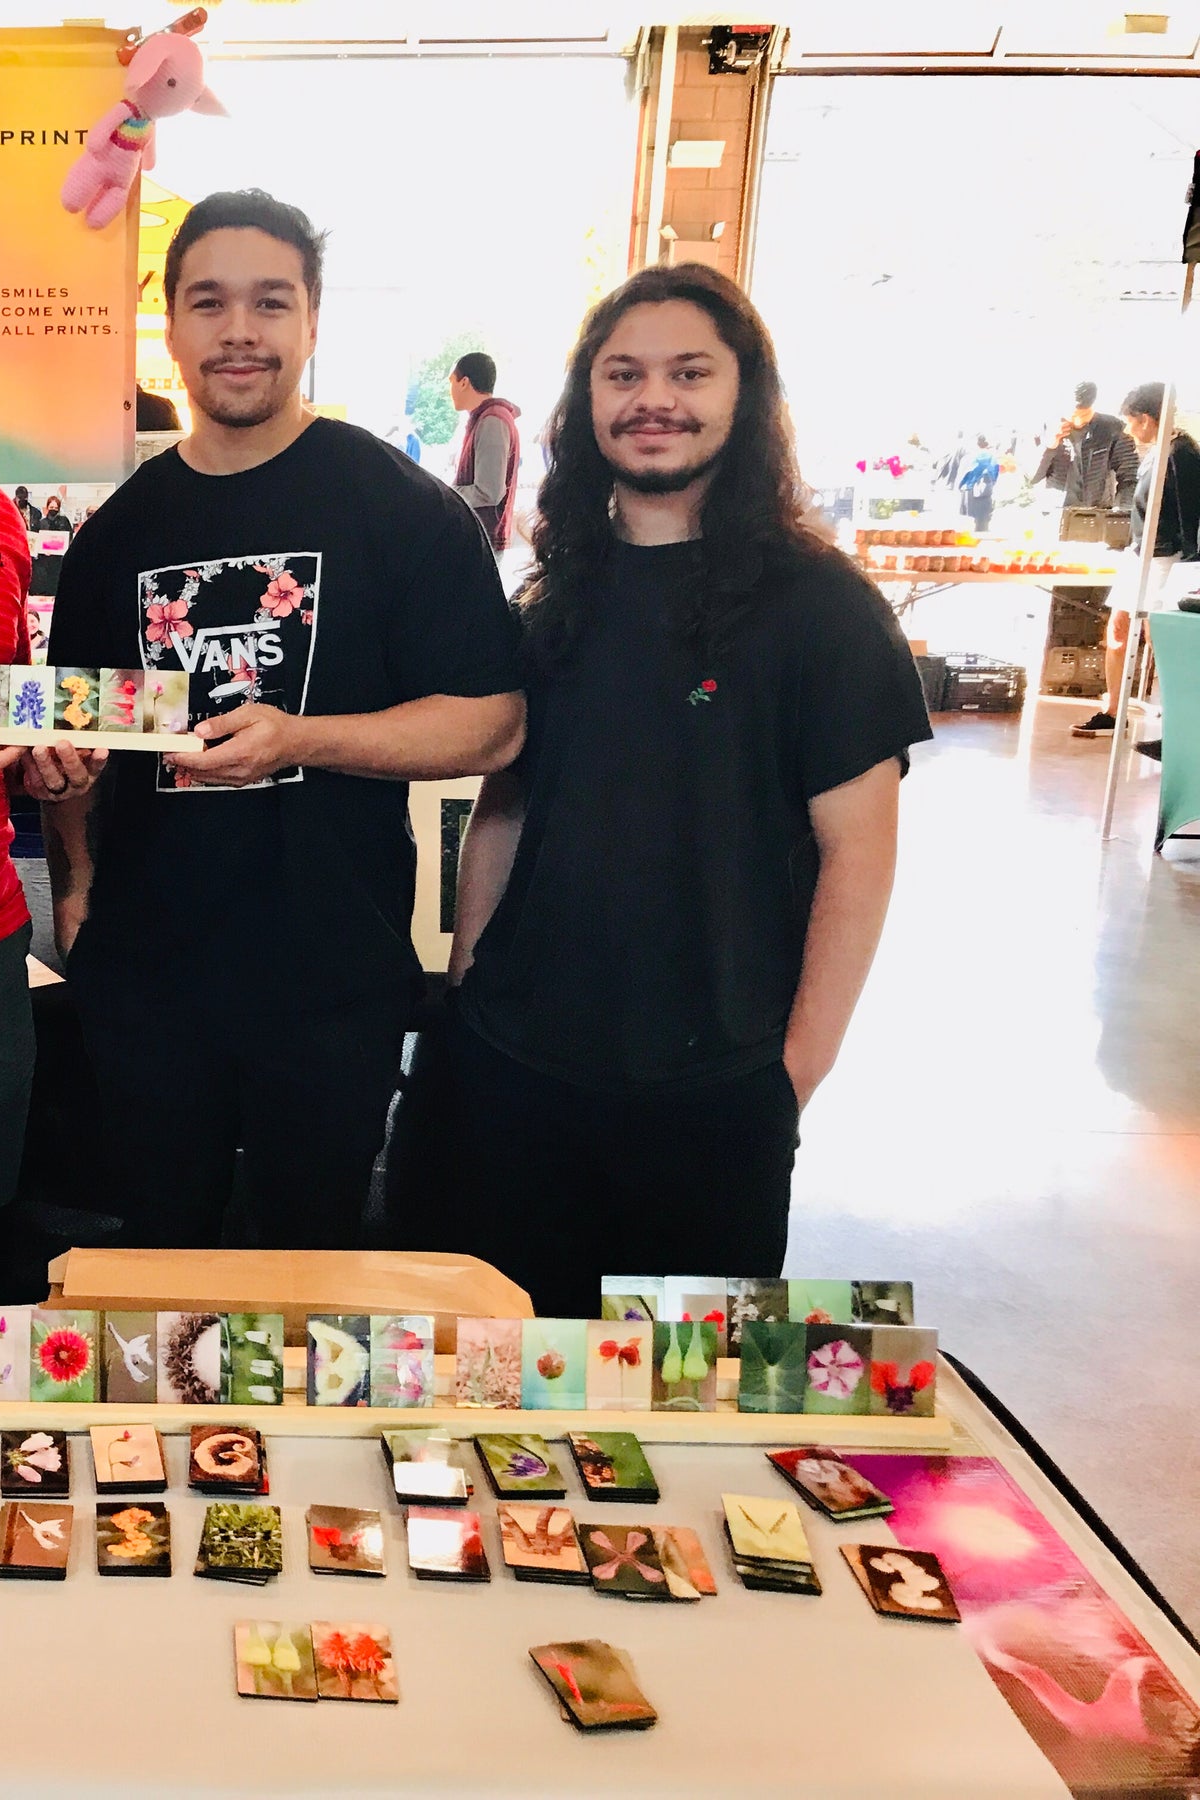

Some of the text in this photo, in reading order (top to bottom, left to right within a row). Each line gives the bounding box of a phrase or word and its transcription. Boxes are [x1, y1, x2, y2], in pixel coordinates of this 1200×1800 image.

[1, 287, 69, 298] SMILES
[1, 306, 109, 317] COME WITH
[2, 325, 119, 336] ALL PRINTS.
[169, 620, 284, 674] VANS
